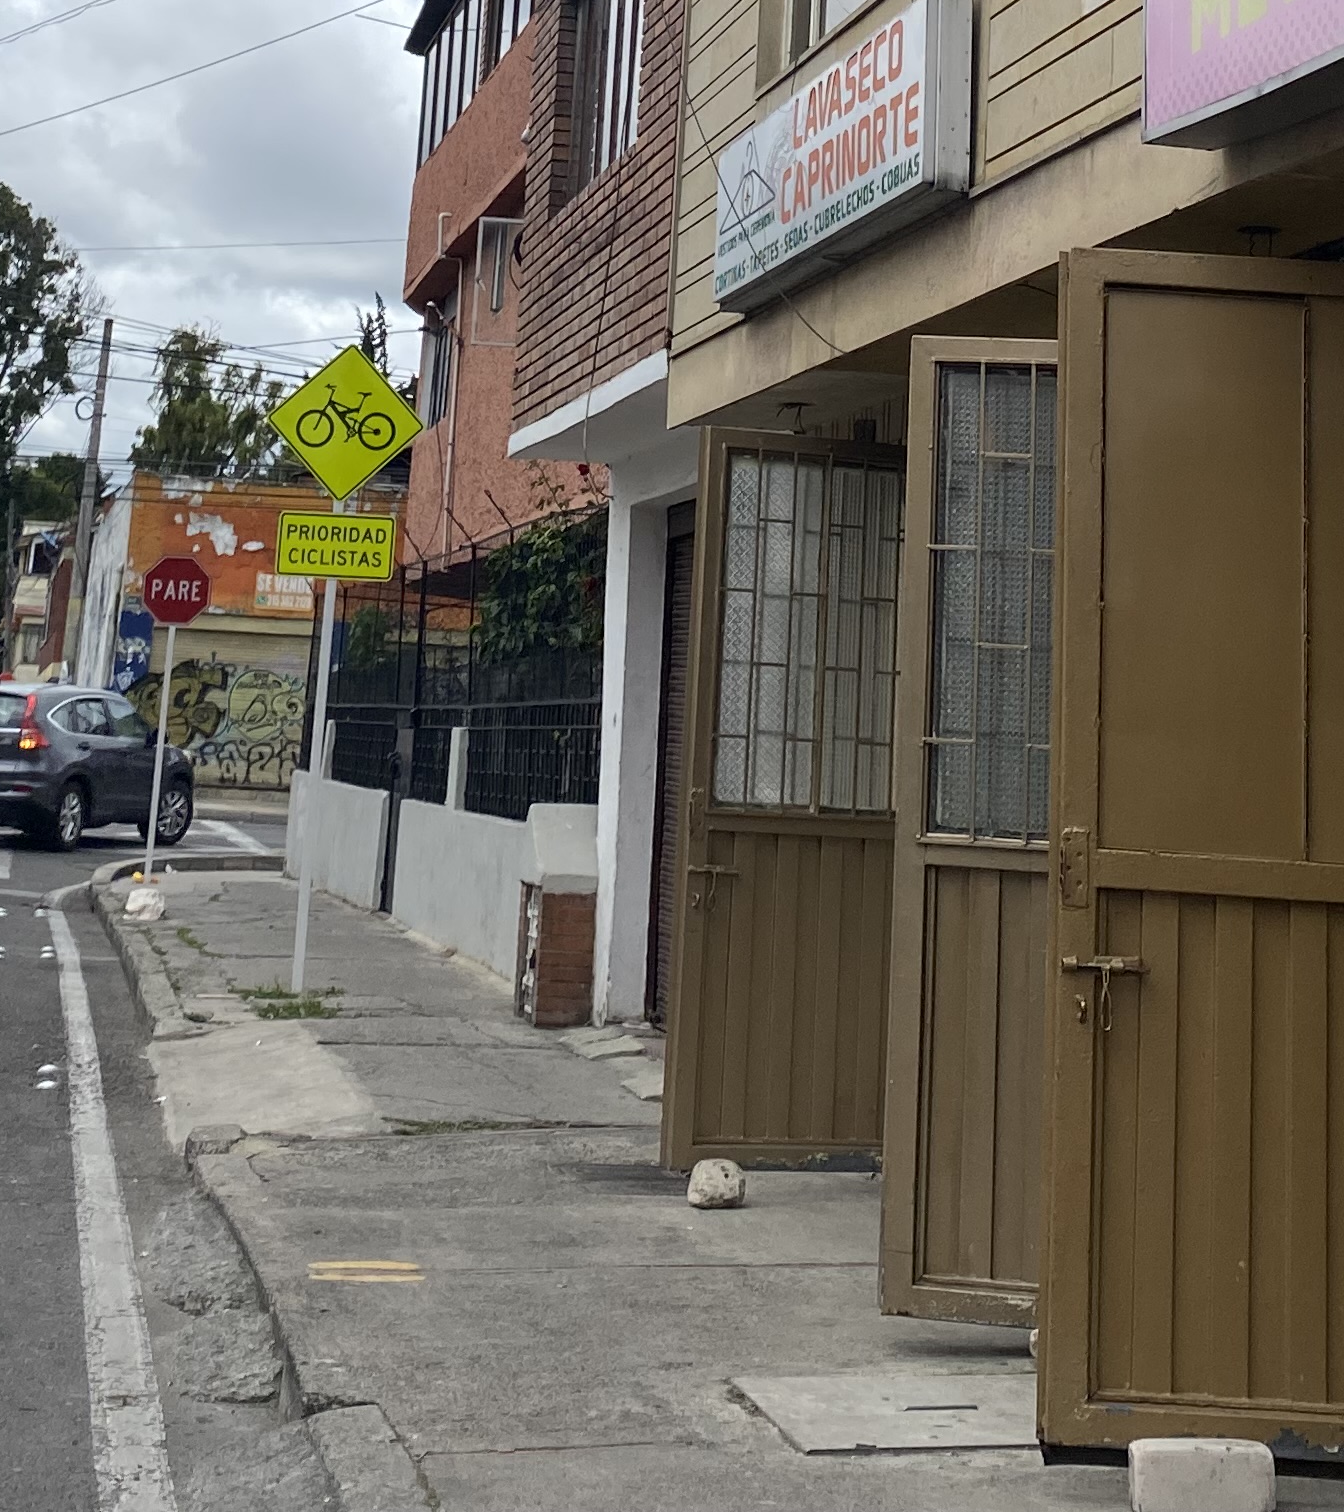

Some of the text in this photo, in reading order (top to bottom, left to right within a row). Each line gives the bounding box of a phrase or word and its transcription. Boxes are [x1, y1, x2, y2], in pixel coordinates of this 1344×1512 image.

[792, 18, 904, 150] LAVASECO
[778, 81, 921, 225] CAPRINORTE
[714, 257, 746, 294] CORTINAS
[750, 238, 779, 273] TAPETES
[784, 220, 809, 254] SEDAS
[814, 178, 875, 236] CUBRELECHOS
[286, 524, 387, 546] PRIORIDAD
[288, 547, 383, 569] CICLISTAS
[151, 579, 202, 602] PARE
